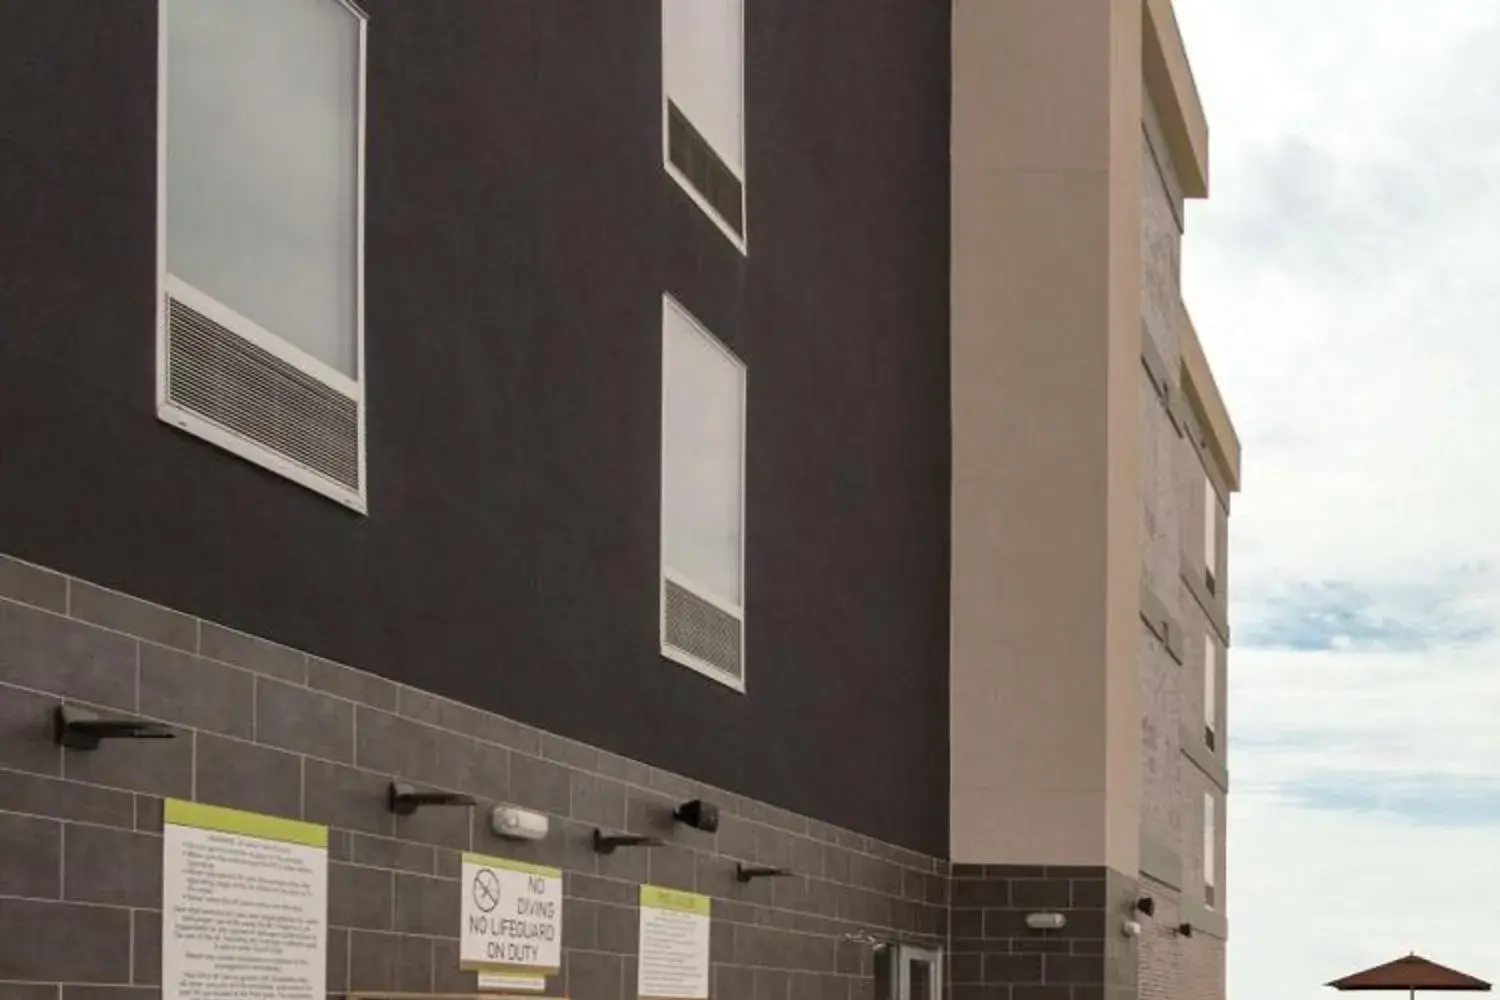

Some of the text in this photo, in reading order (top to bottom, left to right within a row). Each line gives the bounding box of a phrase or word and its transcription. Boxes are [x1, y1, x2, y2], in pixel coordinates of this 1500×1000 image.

[527, 875, 546, 895] NO
[517, 898, 555, 920] DIVING
[469, 914, 556, 942] NO LIFEGUARD
[486, 941, 539, 962] ON DUTY
